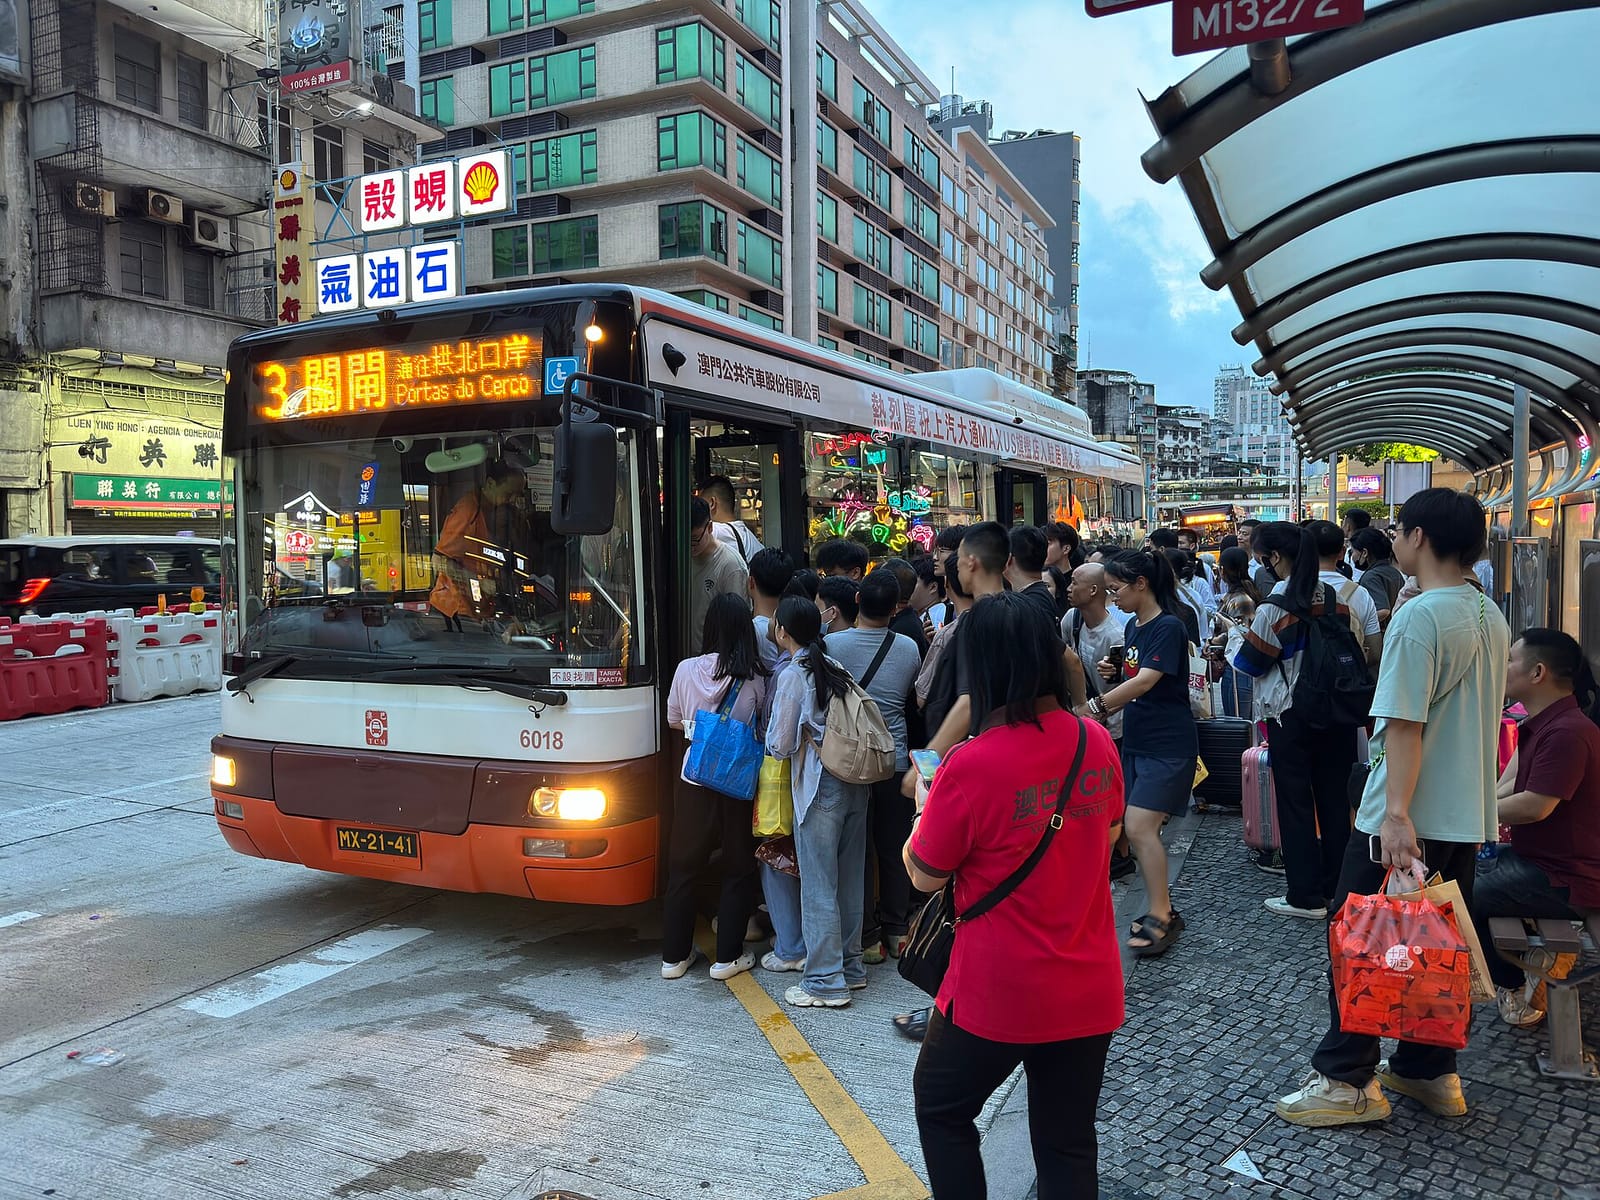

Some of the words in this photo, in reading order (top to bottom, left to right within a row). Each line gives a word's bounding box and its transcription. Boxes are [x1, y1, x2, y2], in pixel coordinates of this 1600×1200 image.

[290, 70, 341, 89] 100%台灣製造
[395, 334, 530, 380] 通往拱北口岸
[261, 362, 289, 418] 3
[304, 350, 386, 413] 關閘
[395, 381, 451, 404] Portas
[455, 377, 474, 399] do
[479, 373, 530, 397] Cerco
[697, 352, 821, 403] 澳門公共汽車股份有限公司
[67, 418, 92, 429] LUEN
[95, 419, 114, 430] YING
[117, 420, 139, 432] HONG
[147, 424, 181, 437] AGENCIA
[183, 427, 222, 440] COMERCIAL
[96, 479, 161, 498] 聯英行
[519, 729, 564, 750] 6018
[339, 830, 413, 855] MX-21-41
